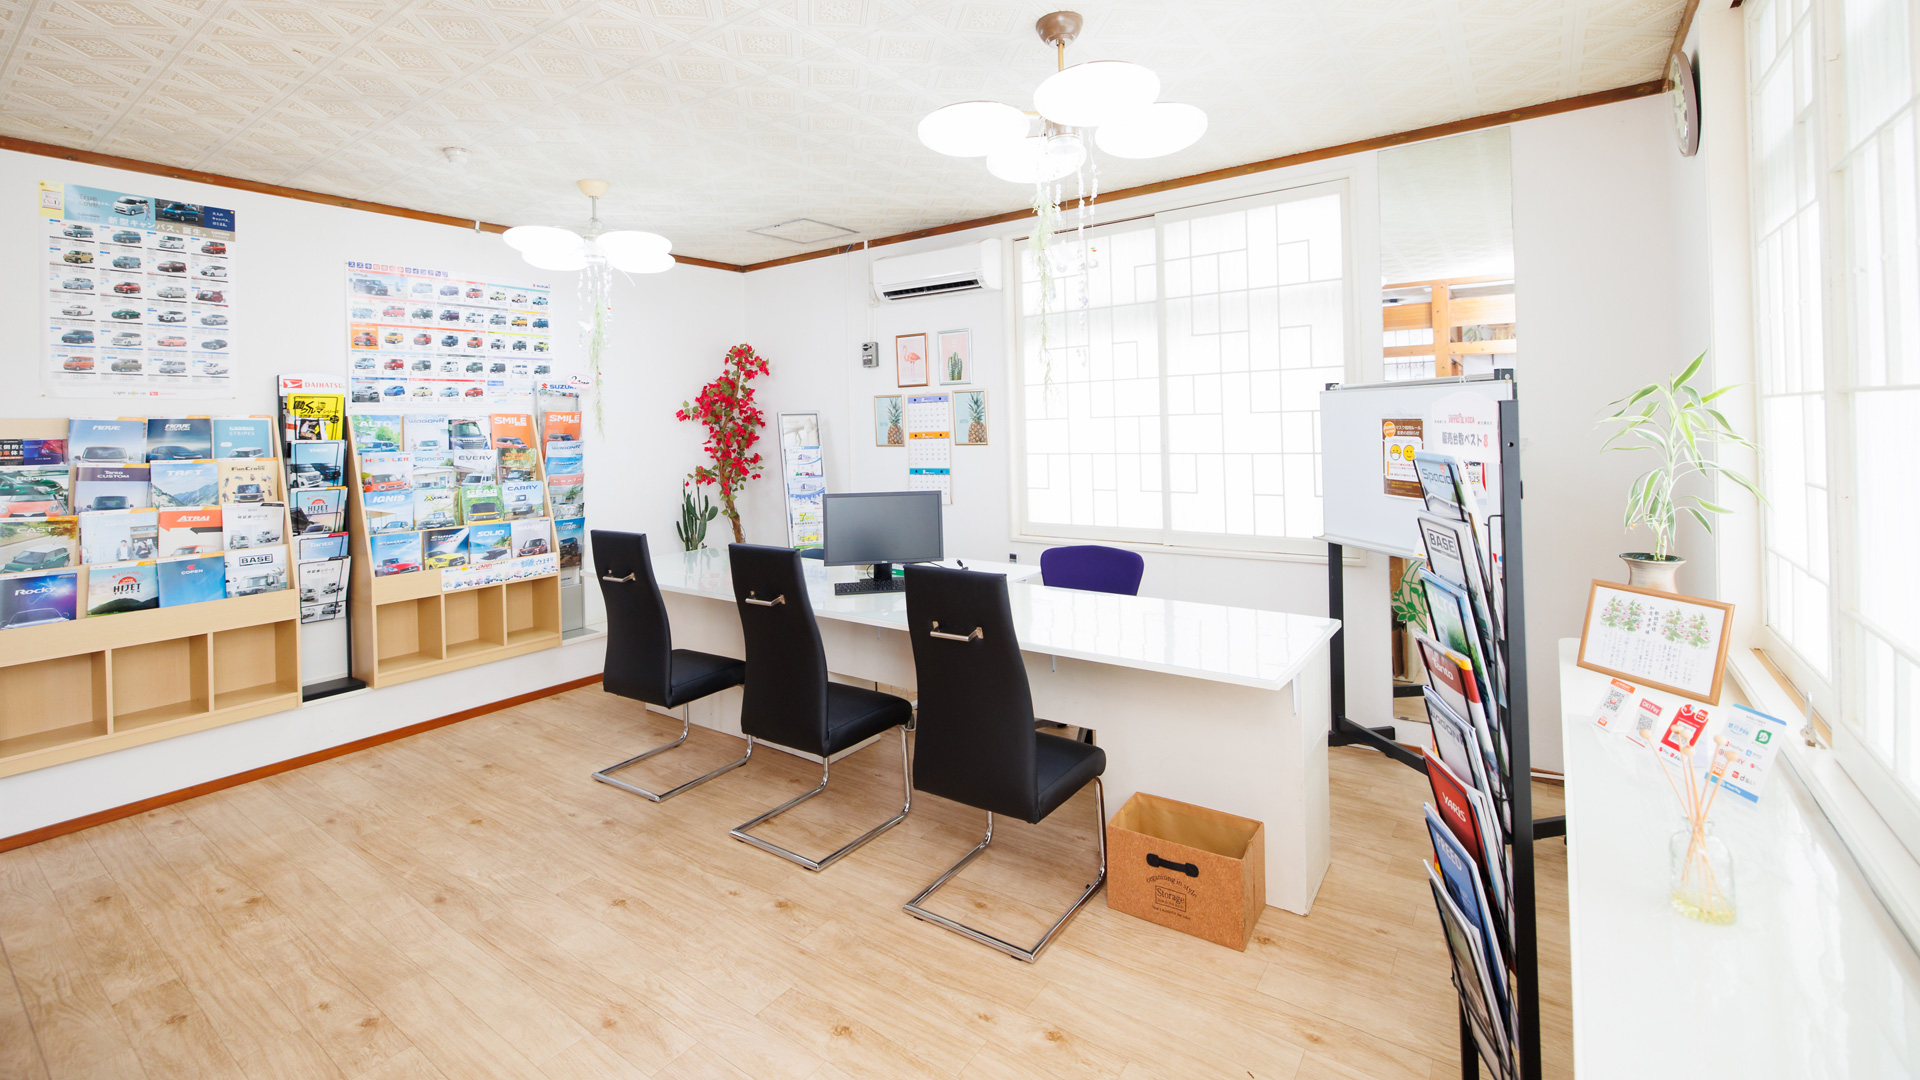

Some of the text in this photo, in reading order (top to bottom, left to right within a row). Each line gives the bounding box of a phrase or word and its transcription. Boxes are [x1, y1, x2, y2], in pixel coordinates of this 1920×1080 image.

[108, 216, 206, 238] 新型キャンバス、誕生。
[494, 416, 527, 426] SMILE
[549, 414, 580, 423] SMILE
[372, 495, 405, 503] IGNIS
[1430, 533, 1456, 554] BASE
[14, 587, 57, 596] Rocky
[113, 583, 141, 592] HIJET
[1428, 589, 1458, 619] ALTO
[1432, 656, 1454, 680] Tanto
[1442, 791, 1466, 822] YARIS
[1436, 832, 1462, 871] FREED
[1156, 888, 1185, 904] Storage
[1184, 884, 1197, 898] style
